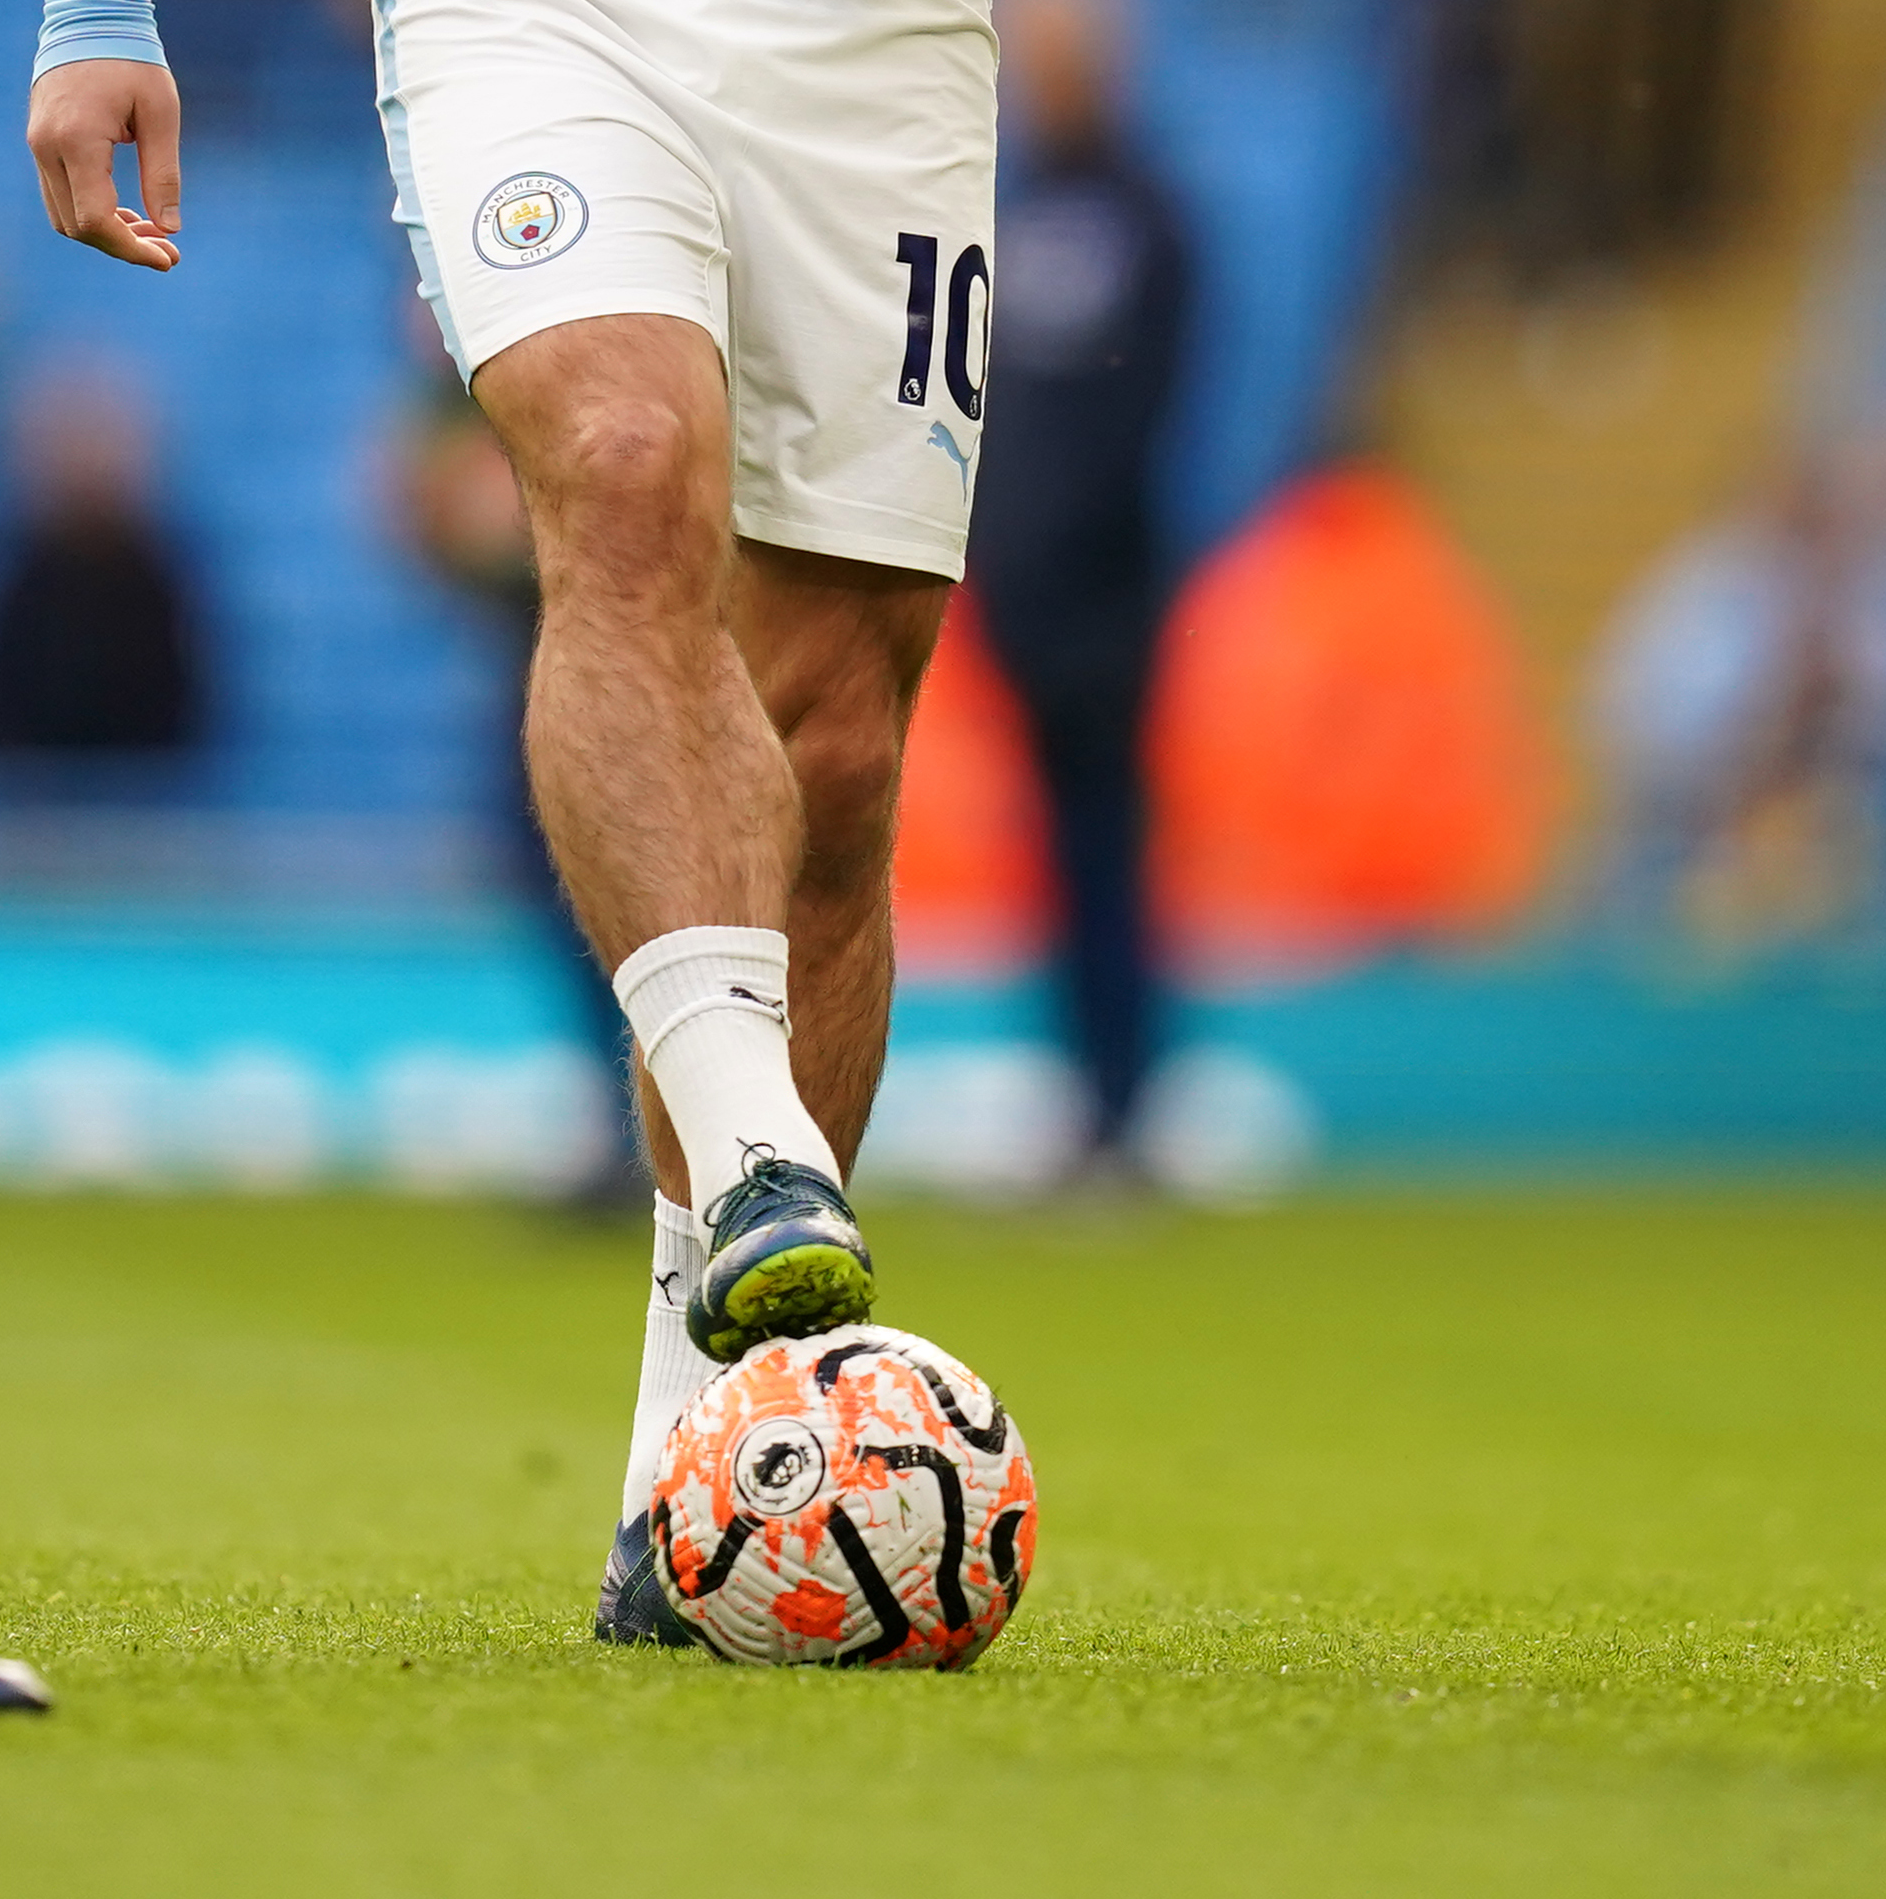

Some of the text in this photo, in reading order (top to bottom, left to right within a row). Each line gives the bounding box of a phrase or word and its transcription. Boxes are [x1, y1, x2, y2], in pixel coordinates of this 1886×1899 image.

[481, 179, 570, 223] MANCHESTER
[520, 244, 552, 262] CITY
[895, 231, 990, 422] 10
